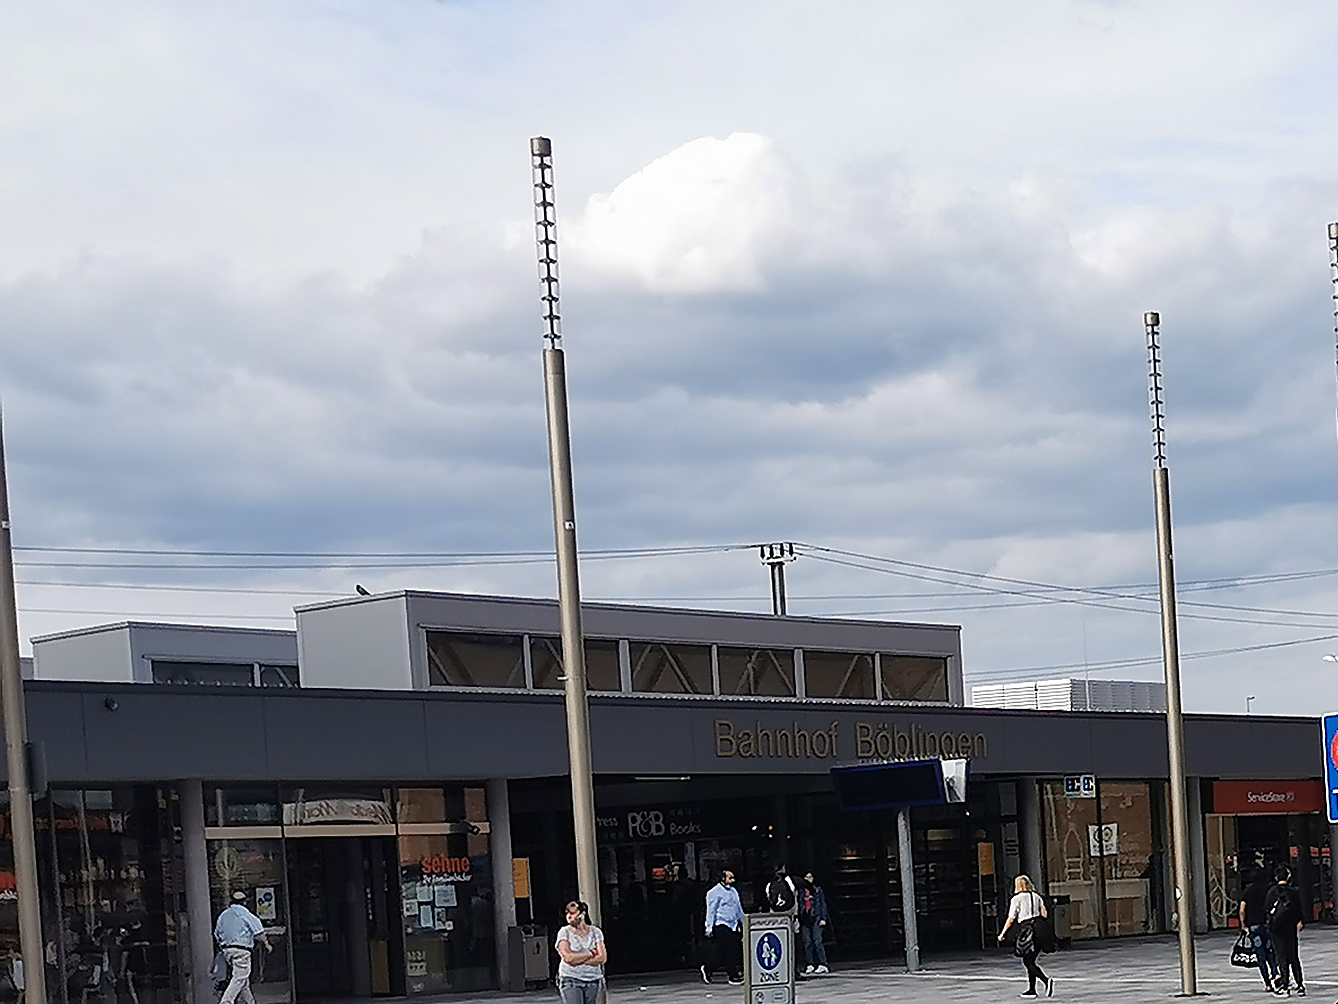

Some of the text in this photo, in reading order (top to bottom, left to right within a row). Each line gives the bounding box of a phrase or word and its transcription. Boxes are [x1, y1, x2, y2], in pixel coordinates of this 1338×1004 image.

[714, 719, 988, 759] Bahnhof Böblingen
[597, 816, 618, 827] ress
[669, 822, 701, 836] Books
[421, 853, 470, 874] sehne
[760, 971, 780, 982] ZONE
